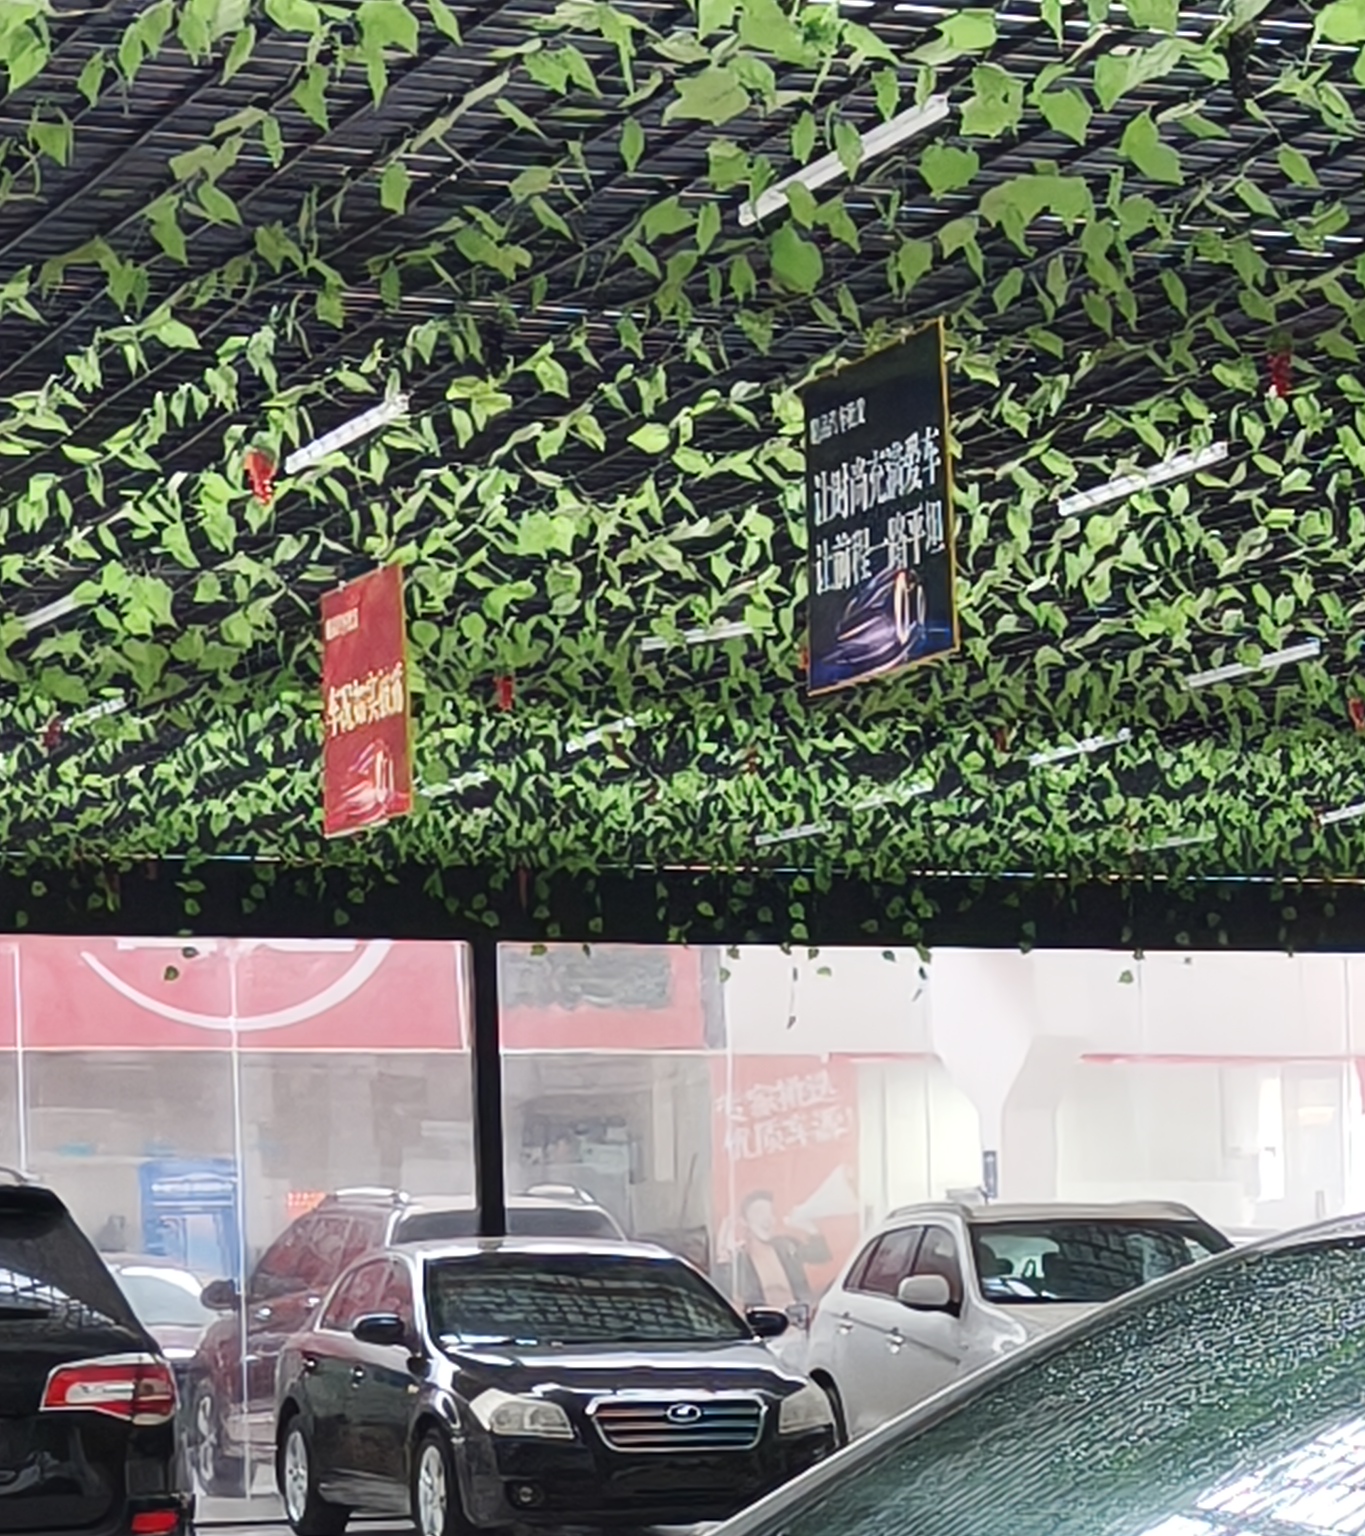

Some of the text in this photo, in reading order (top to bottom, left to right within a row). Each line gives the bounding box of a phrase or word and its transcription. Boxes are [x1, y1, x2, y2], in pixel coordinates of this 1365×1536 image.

[813, 425, 942, 527] 让时尚充满爱车
[815, 500, 946, 595] 让前程一路平坦
